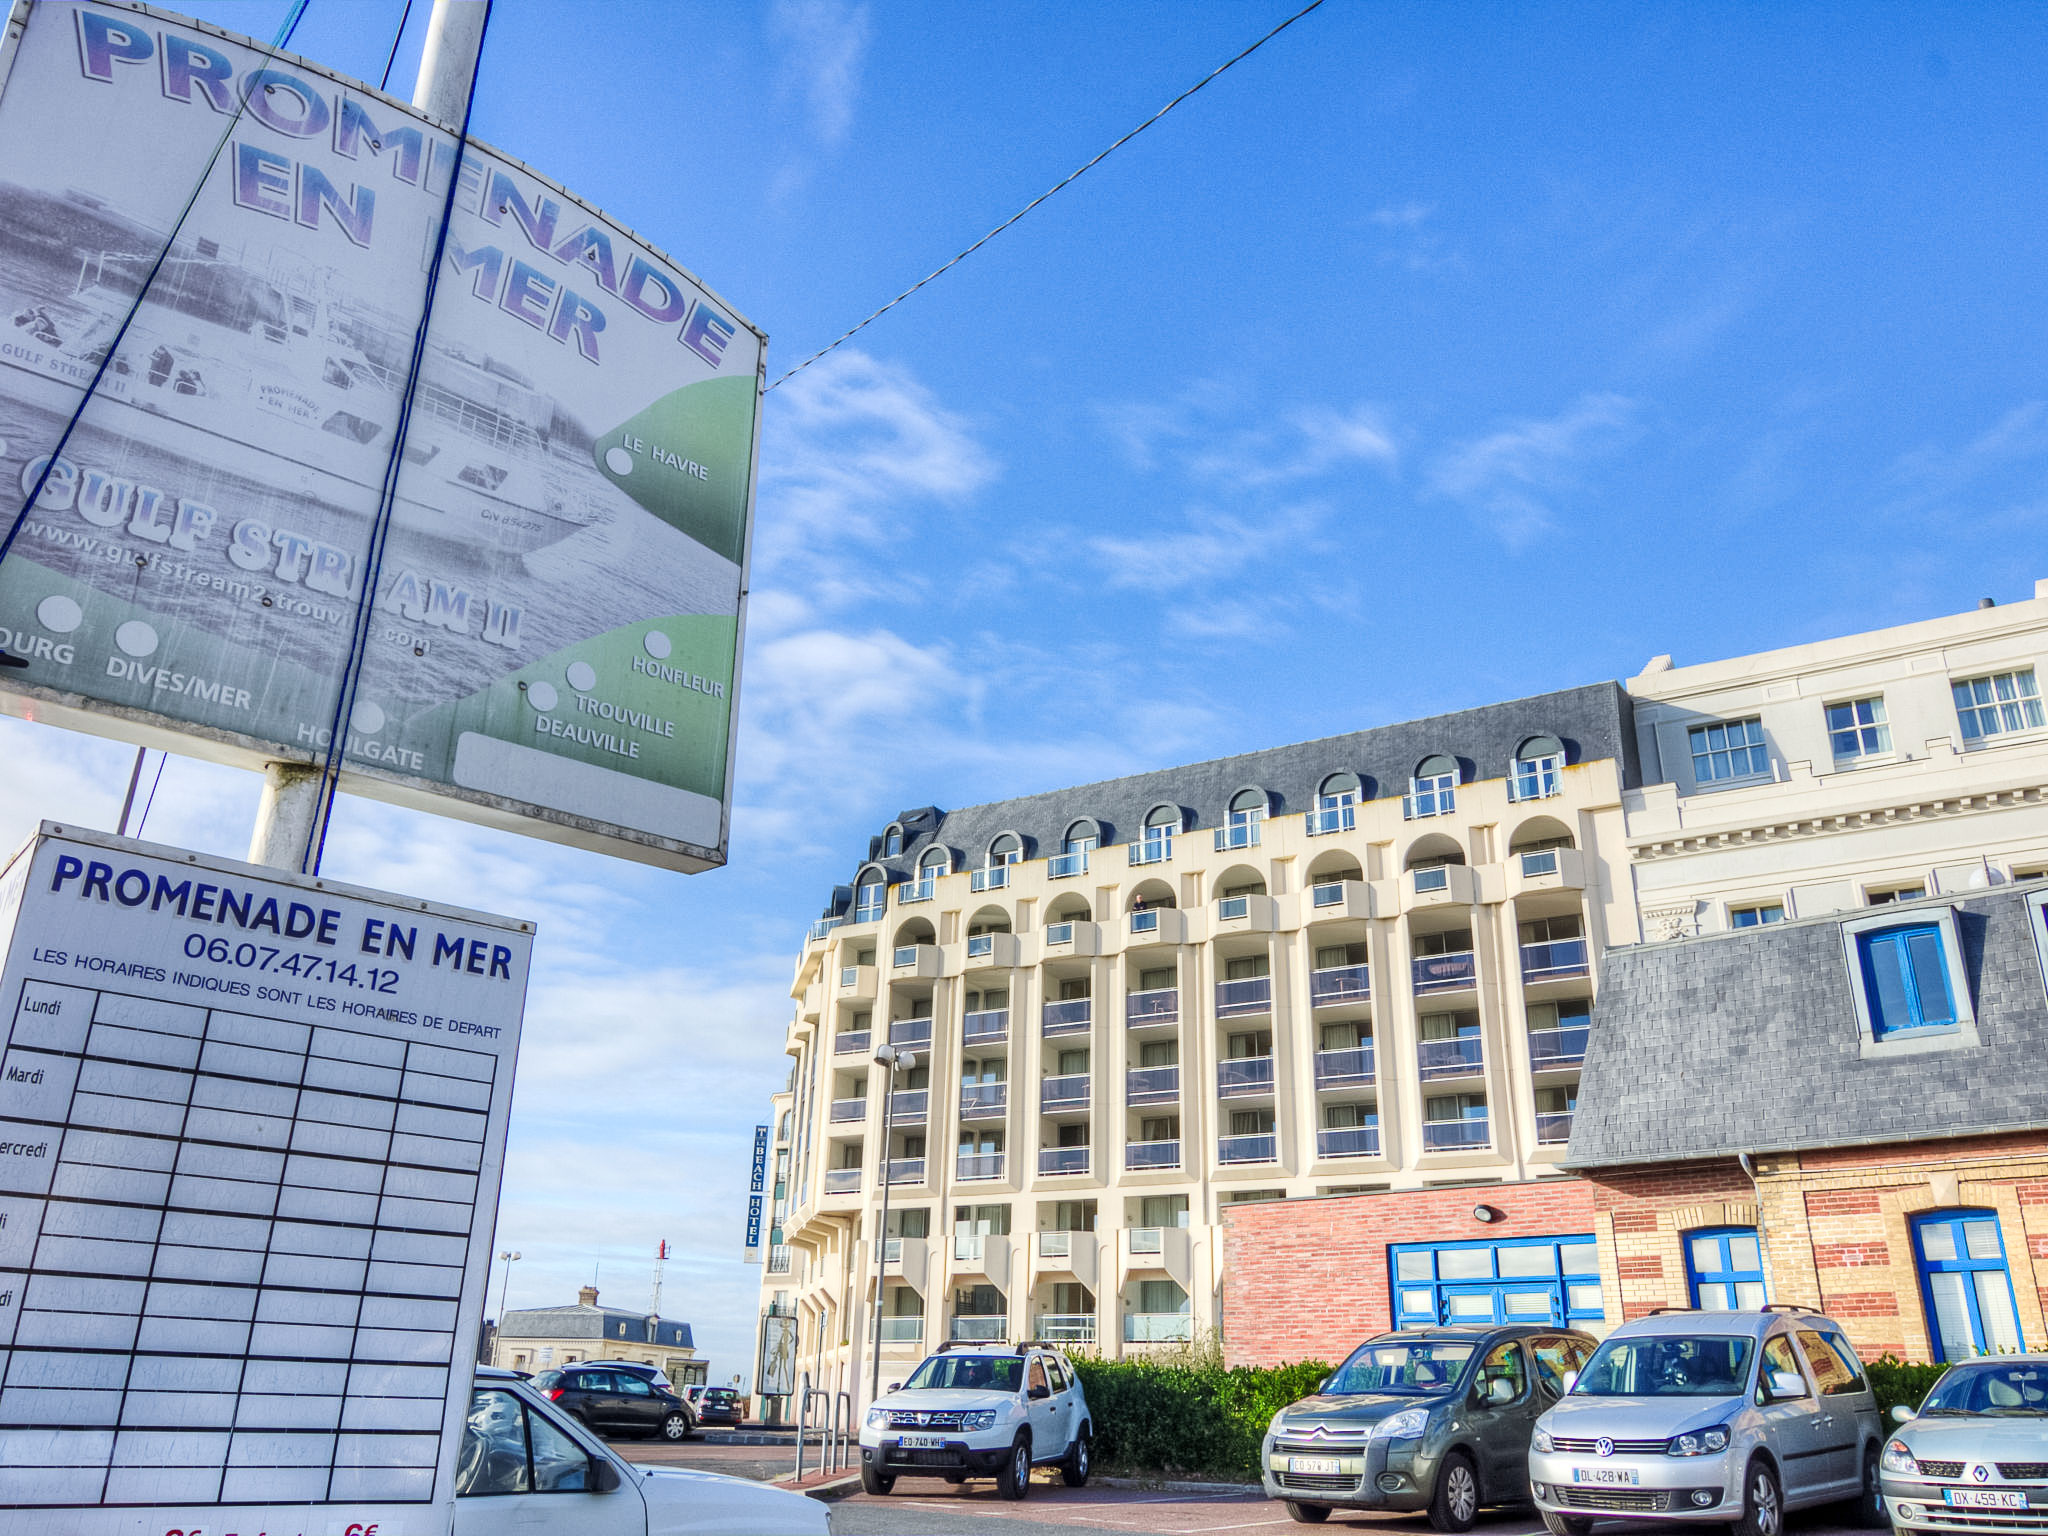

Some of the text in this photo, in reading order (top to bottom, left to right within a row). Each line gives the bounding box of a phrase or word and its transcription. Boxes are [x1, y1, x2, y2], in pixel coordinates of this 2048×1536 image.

[73, 8, 736, 370] PROMENADE
[232, 140, 607, 366] EN MER
[1, 342, 44, 366] GULF
[623, 433, 709, 481] LE HAVRE
[20, 454, 219, 552] GULF
[481, 598, 525, 651] II
[106, 656, 251, 710] DIVES/MER
[632, 655, 725, 698] HONFLEUR
[535, 714, 640, 759] DEAUVILLE
[576, 694, 675, 739] TROUVILLE
[51, 854, 341, 945] PROMENADE
[361, 918, 417, 961] EN
[432, 932, 512, 980] MER
[184, 933, 400, 994] 06.07.47.14.12
[24, 997, 61, 1015] Lundi
[33, 948, 502, 1040] LES HORAIRES INDIQUES SONT LES HORAIRES DE DEPART
[6, 1066, 45, 1084] Mardi
[752, 1147, 765, 1190] BEACH
[748, 1198, 760, 1244] HOTEL
